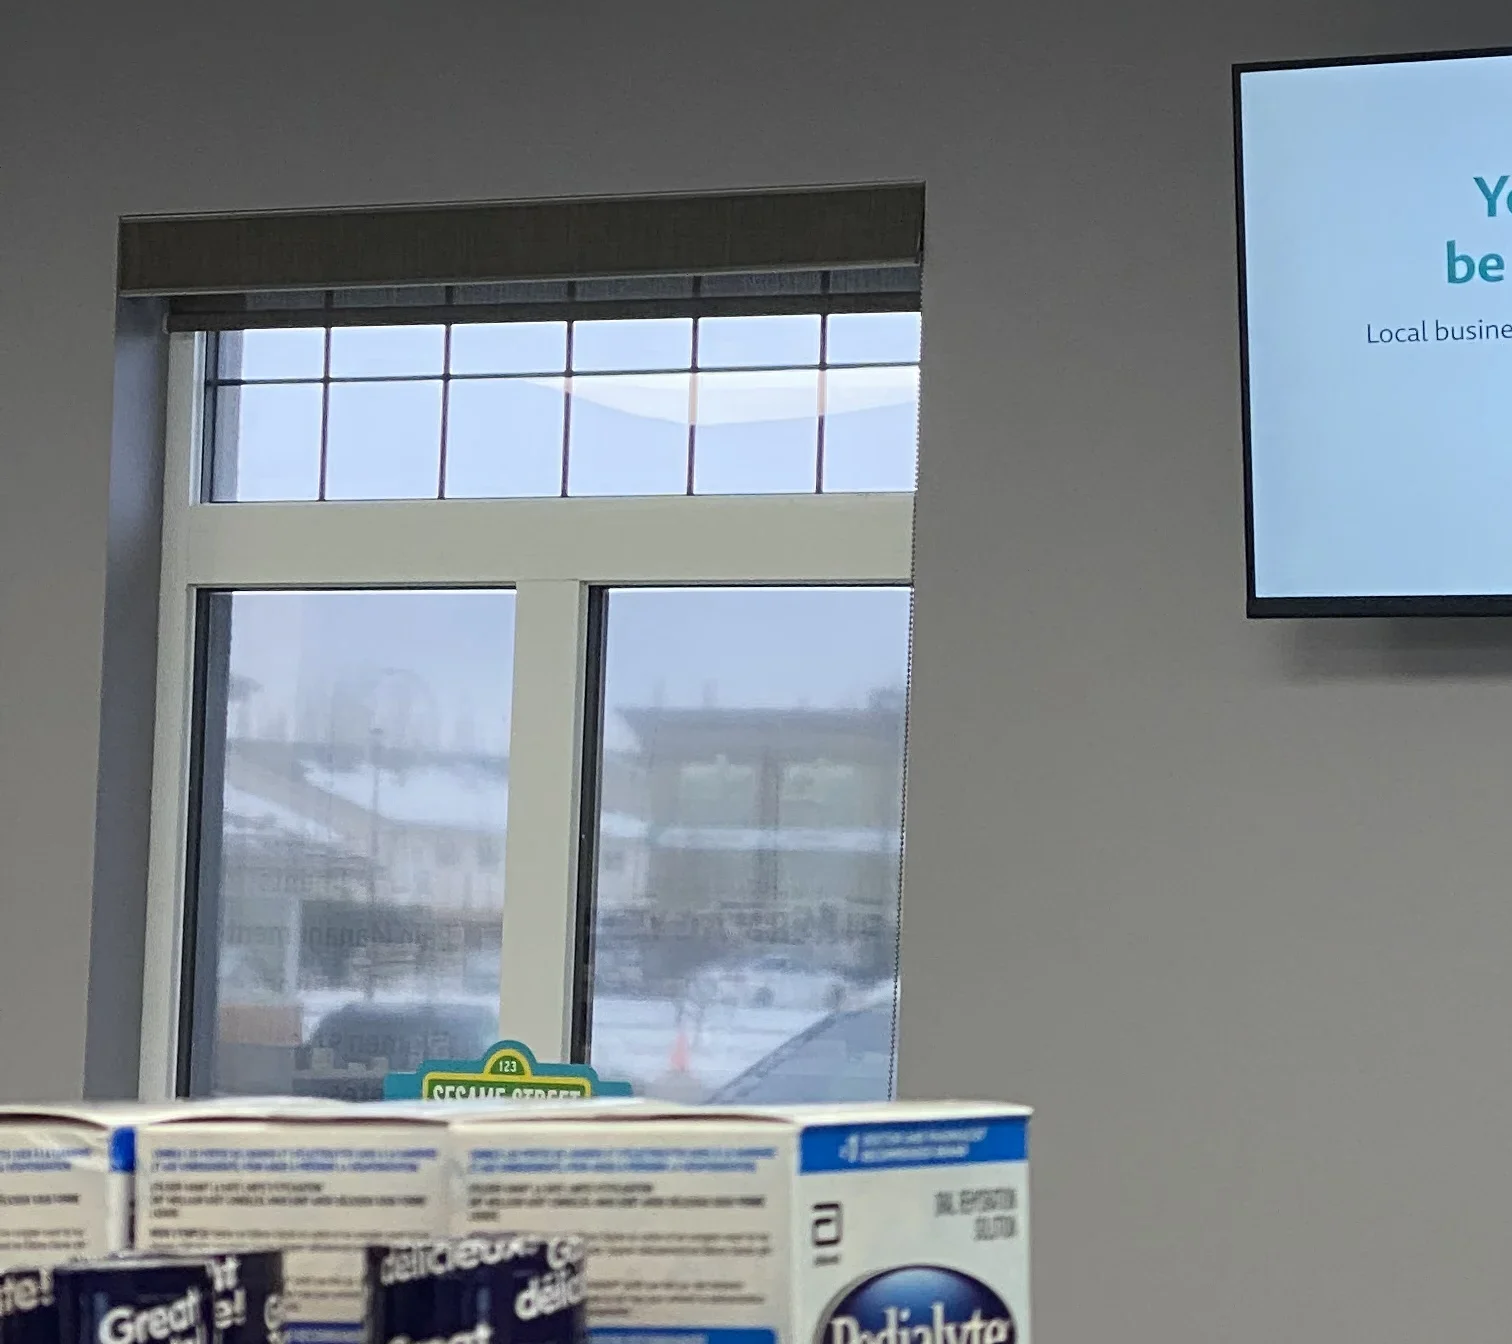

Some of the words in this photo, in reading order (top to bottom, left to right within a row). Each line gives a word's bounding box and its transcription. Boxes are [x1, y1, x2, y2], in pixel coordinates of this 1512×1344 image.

[1446, 238, 1506, 285] be
[1366, 318, 1429, 345] Local
[499, 1060, 517, 1073] 123
